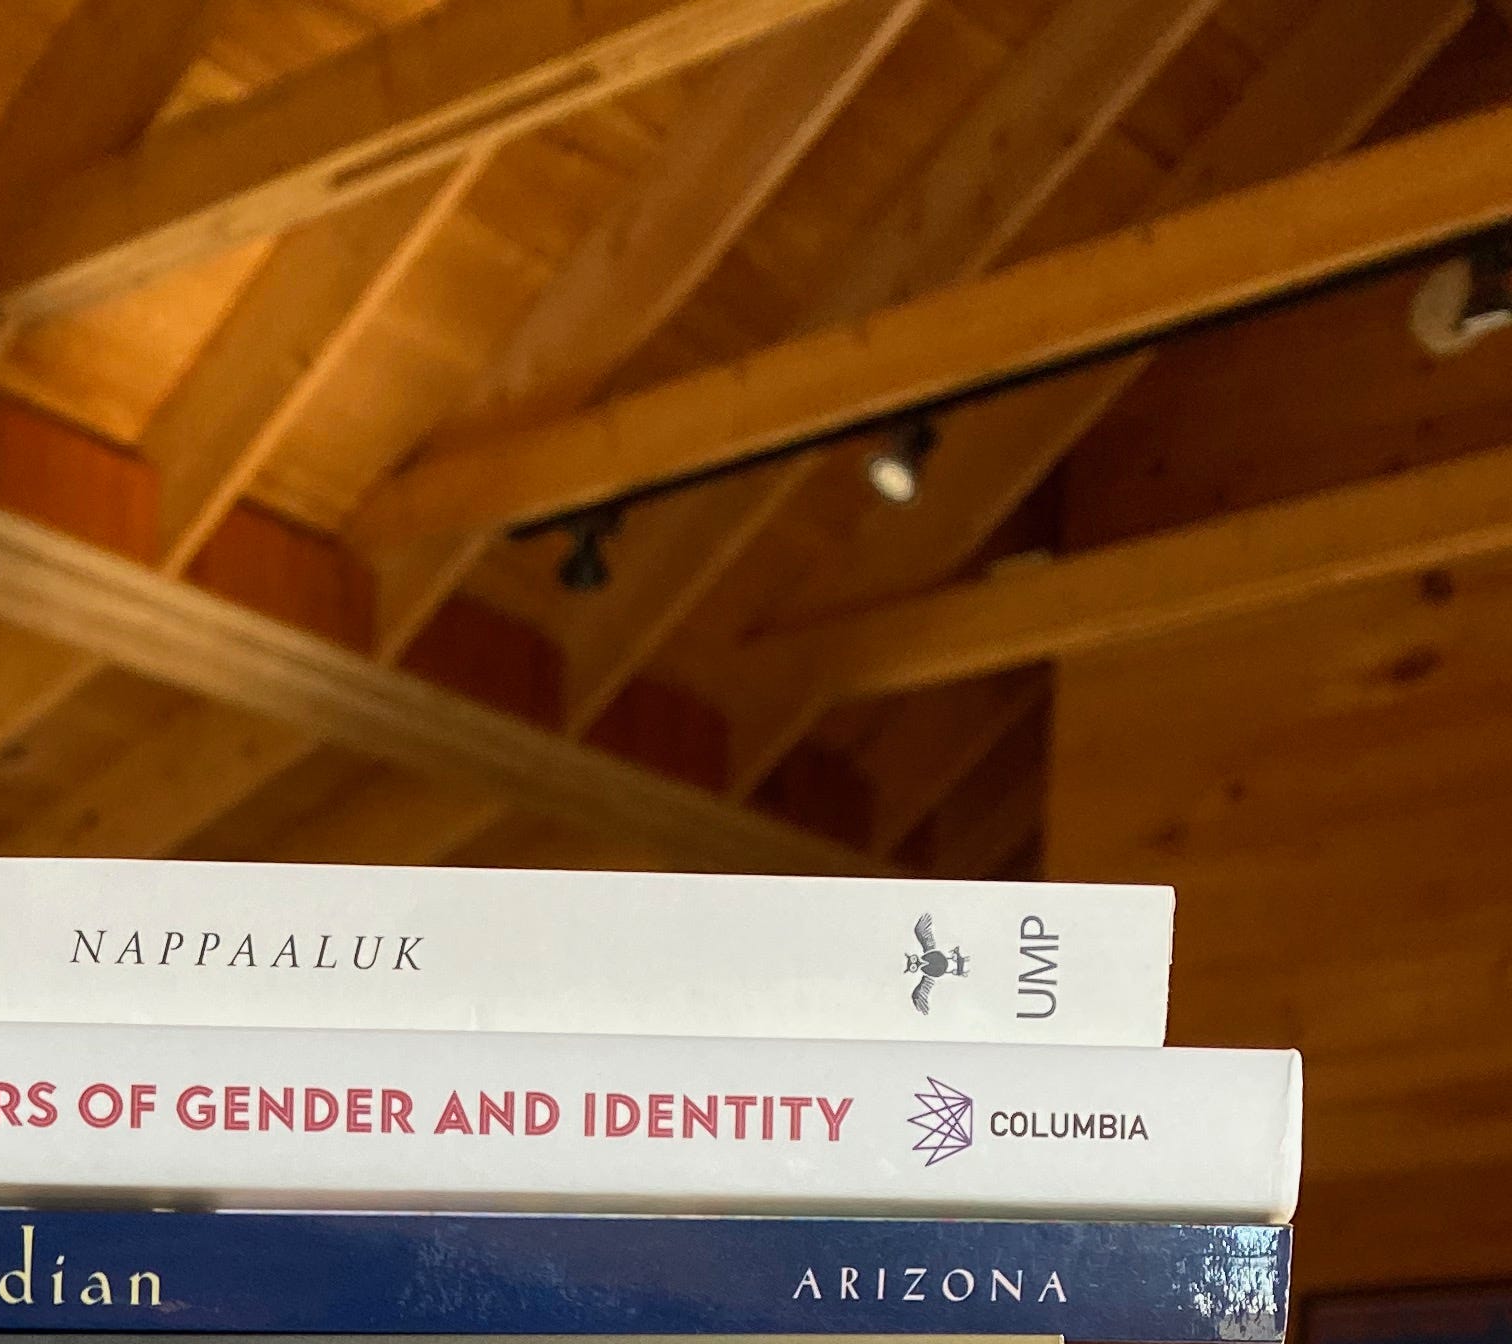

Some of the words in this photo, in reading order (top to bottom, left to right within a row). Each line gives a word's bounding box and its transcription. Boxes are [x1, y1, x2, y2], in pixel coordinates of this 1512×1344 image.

[69, 929, 426, 972] NAPPAALUK
[1015, 914, 1061, 1020] UMP
[78, 1083, 156, 1130] OF
[176, 1085, 415, 1135] GENDER
[433, 1088, 561, 1139] AND
[583, 1092, 854, 1142] IDENTITY
[989, 1109, 1149, 1141] COLUMBIA
[793, 1266, 1068, 1304] ARIZONA
